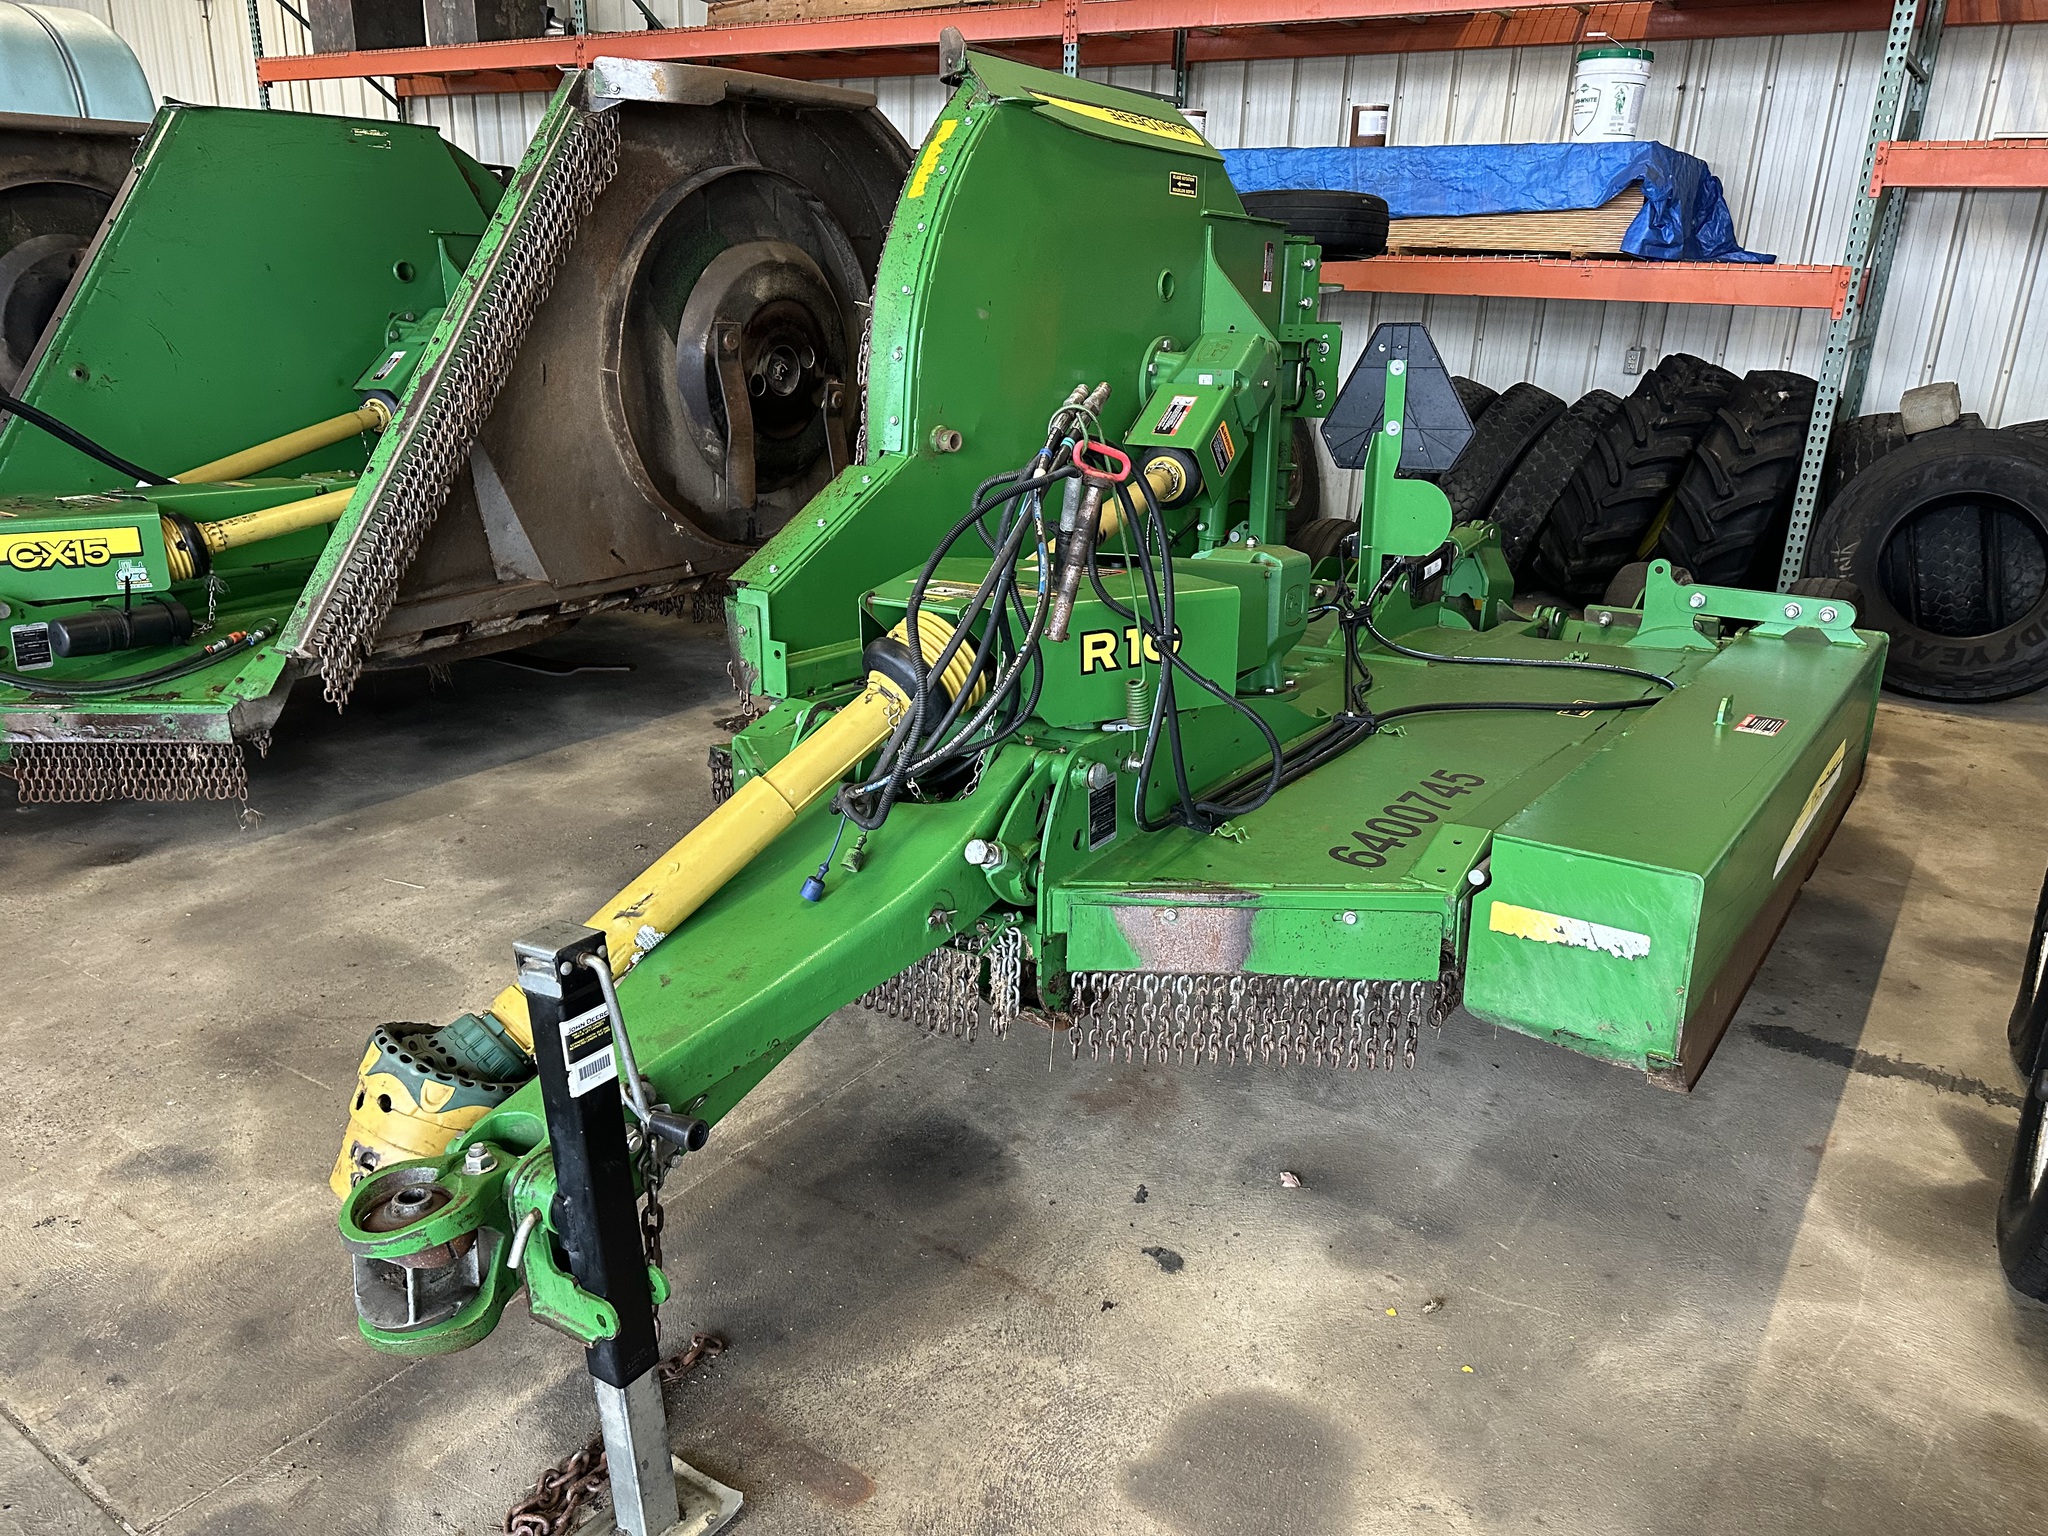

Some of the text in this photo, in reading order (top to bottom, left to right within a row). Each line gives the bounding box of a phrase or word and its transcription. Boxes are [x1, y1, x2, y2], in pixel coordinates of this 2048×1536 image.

[1108, 109, 1158, 131] DEERE
[1328, 769, 1485, 867] 6400745
[568, 1022, 586, 1035] JOHN
